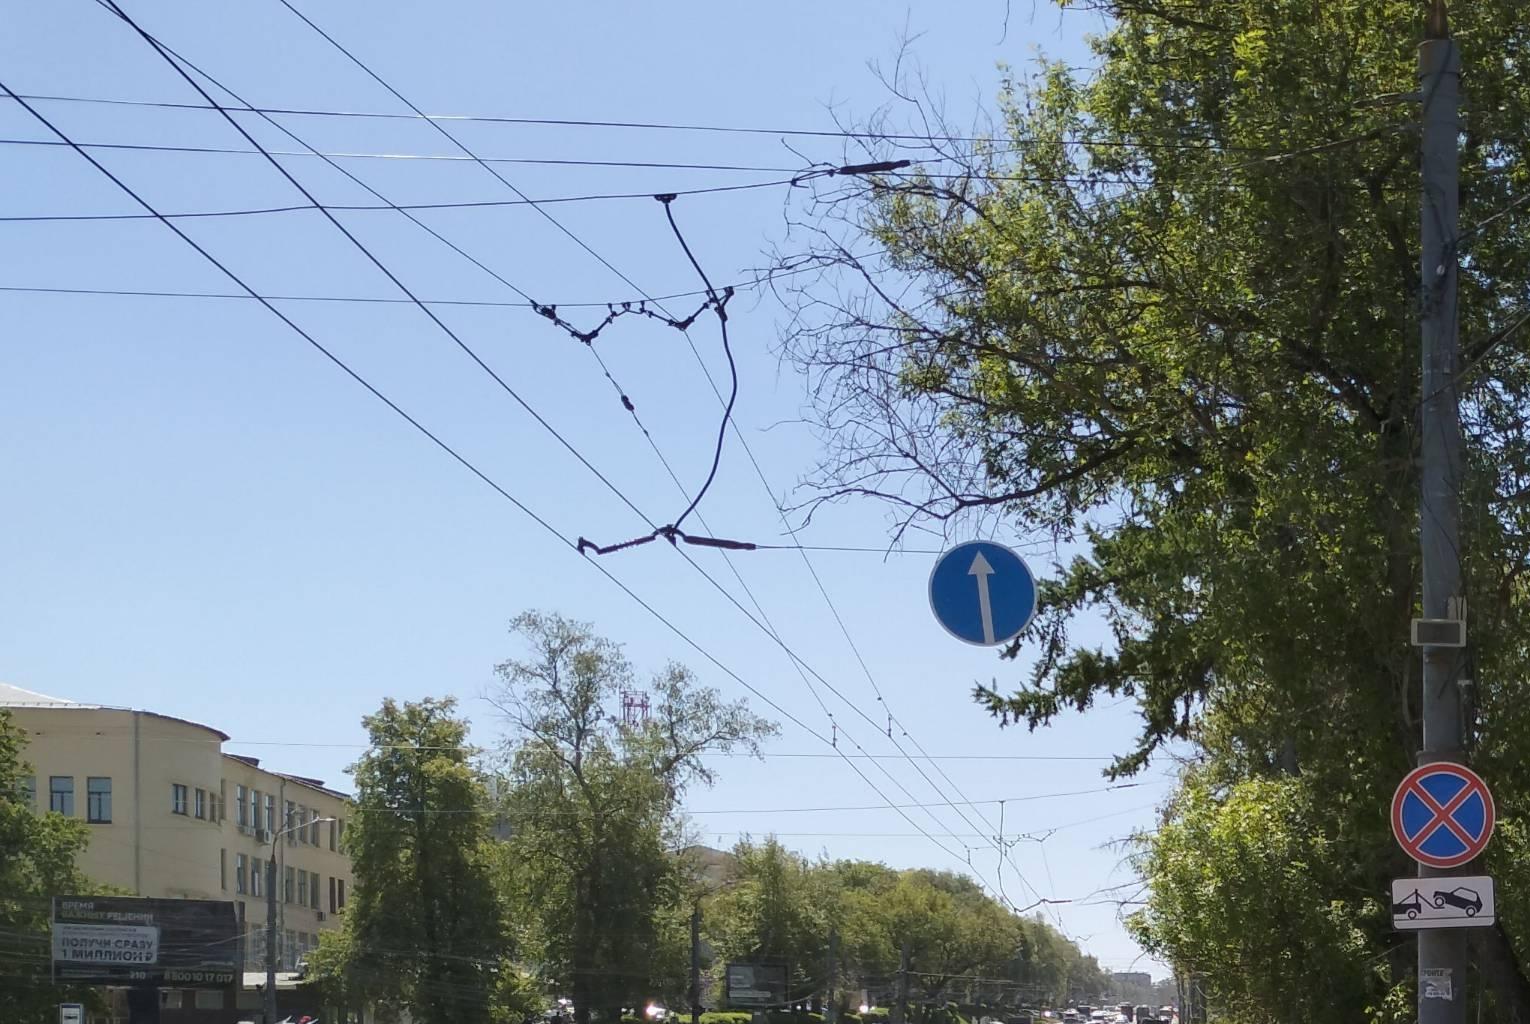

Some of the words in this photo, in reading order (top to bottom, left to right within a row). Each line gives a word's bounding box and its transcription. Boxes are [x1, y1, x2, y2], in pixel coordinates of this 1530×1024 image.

[62, 937, 111, 948] ПОЛУЧИ
[114, 939, 153, 949] СРАЗУ
[72, 949, 143, 961] МИЛЛИОН
